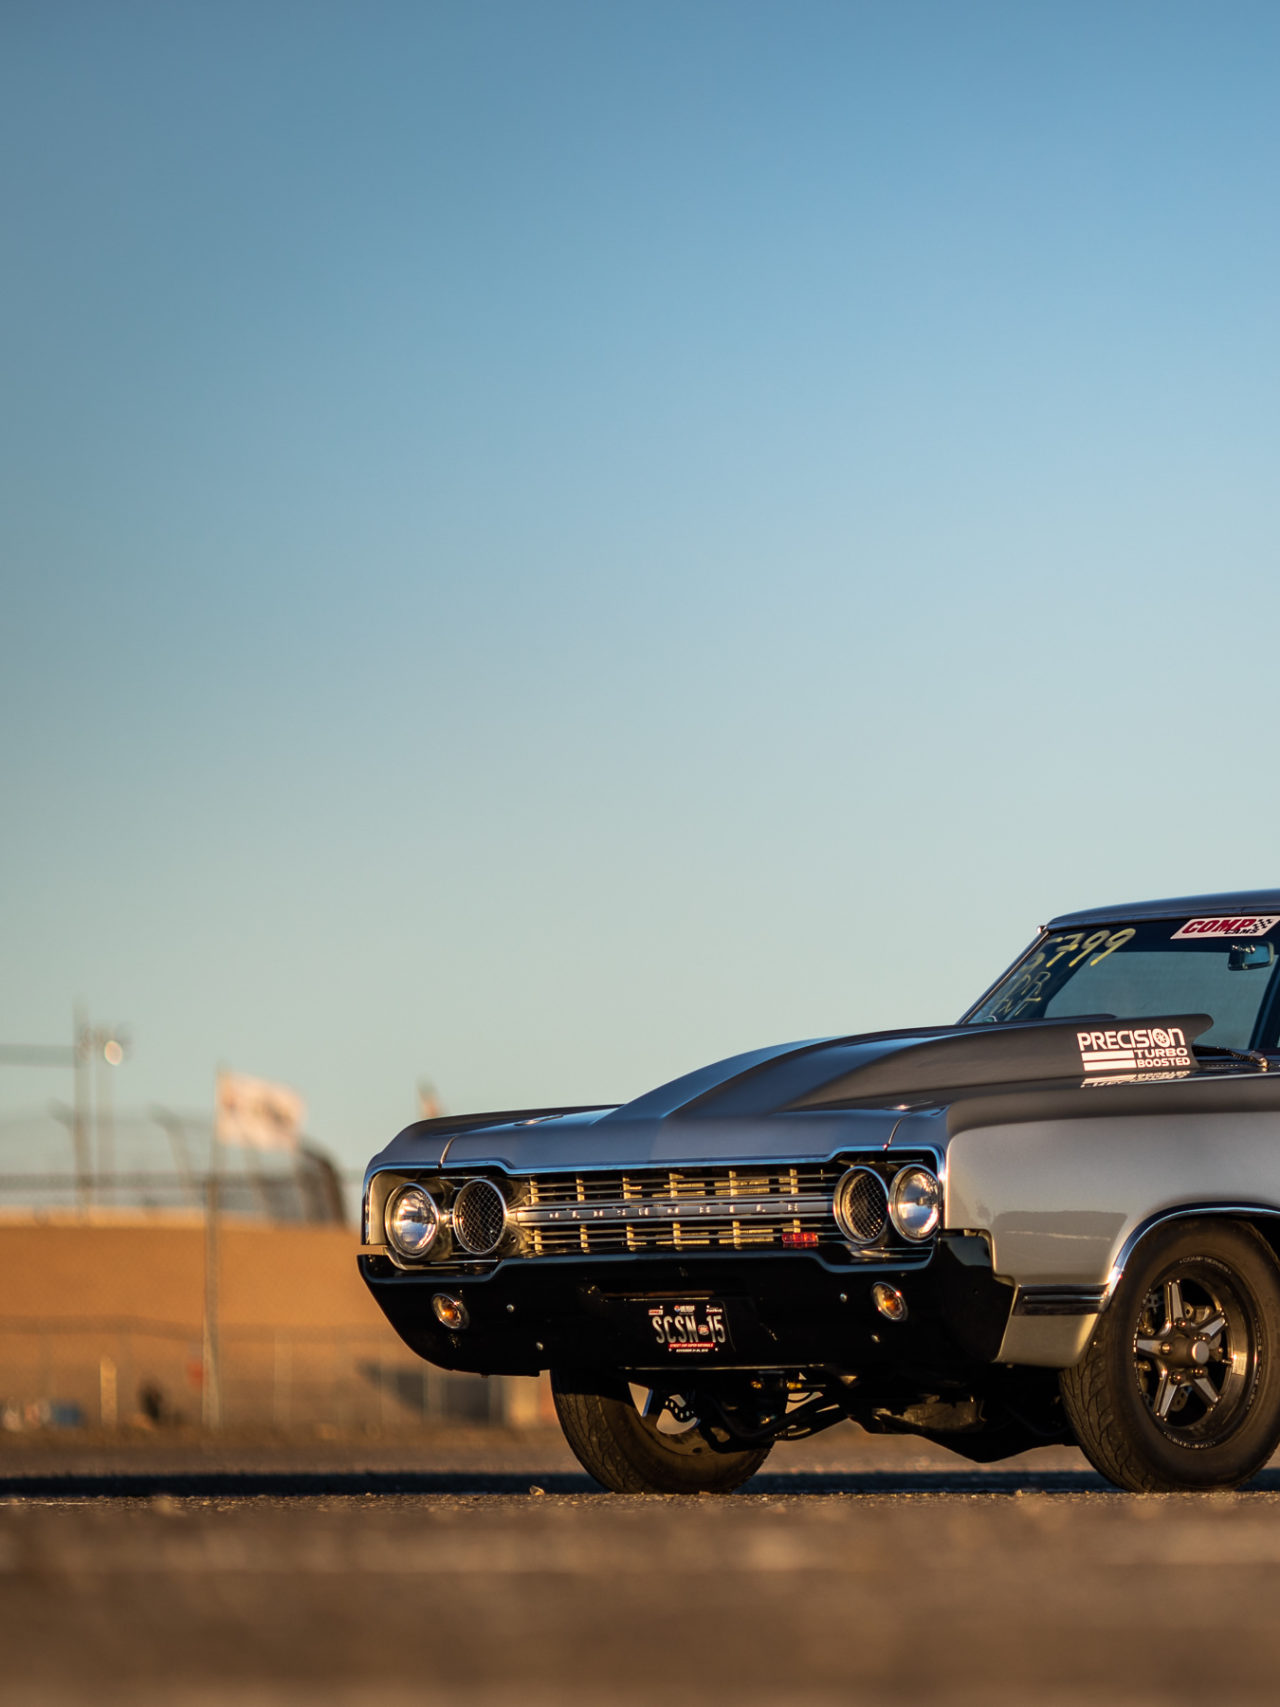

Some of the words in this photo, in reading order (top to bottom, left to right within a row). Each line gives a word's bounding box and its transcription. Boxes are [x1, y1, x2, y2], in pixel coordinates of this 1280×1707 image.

[1182, 919, 1257, 934] COMP
[1077, 1027, 1186, 1052] PRECISION
[1134, 1047, 1188, 1059] TURBO
[1137, 1057, 1191, 1069] BOOSTED
[652, 1315, 699, 1344] SCSN
[706, 1314, 726, 1343] 15
